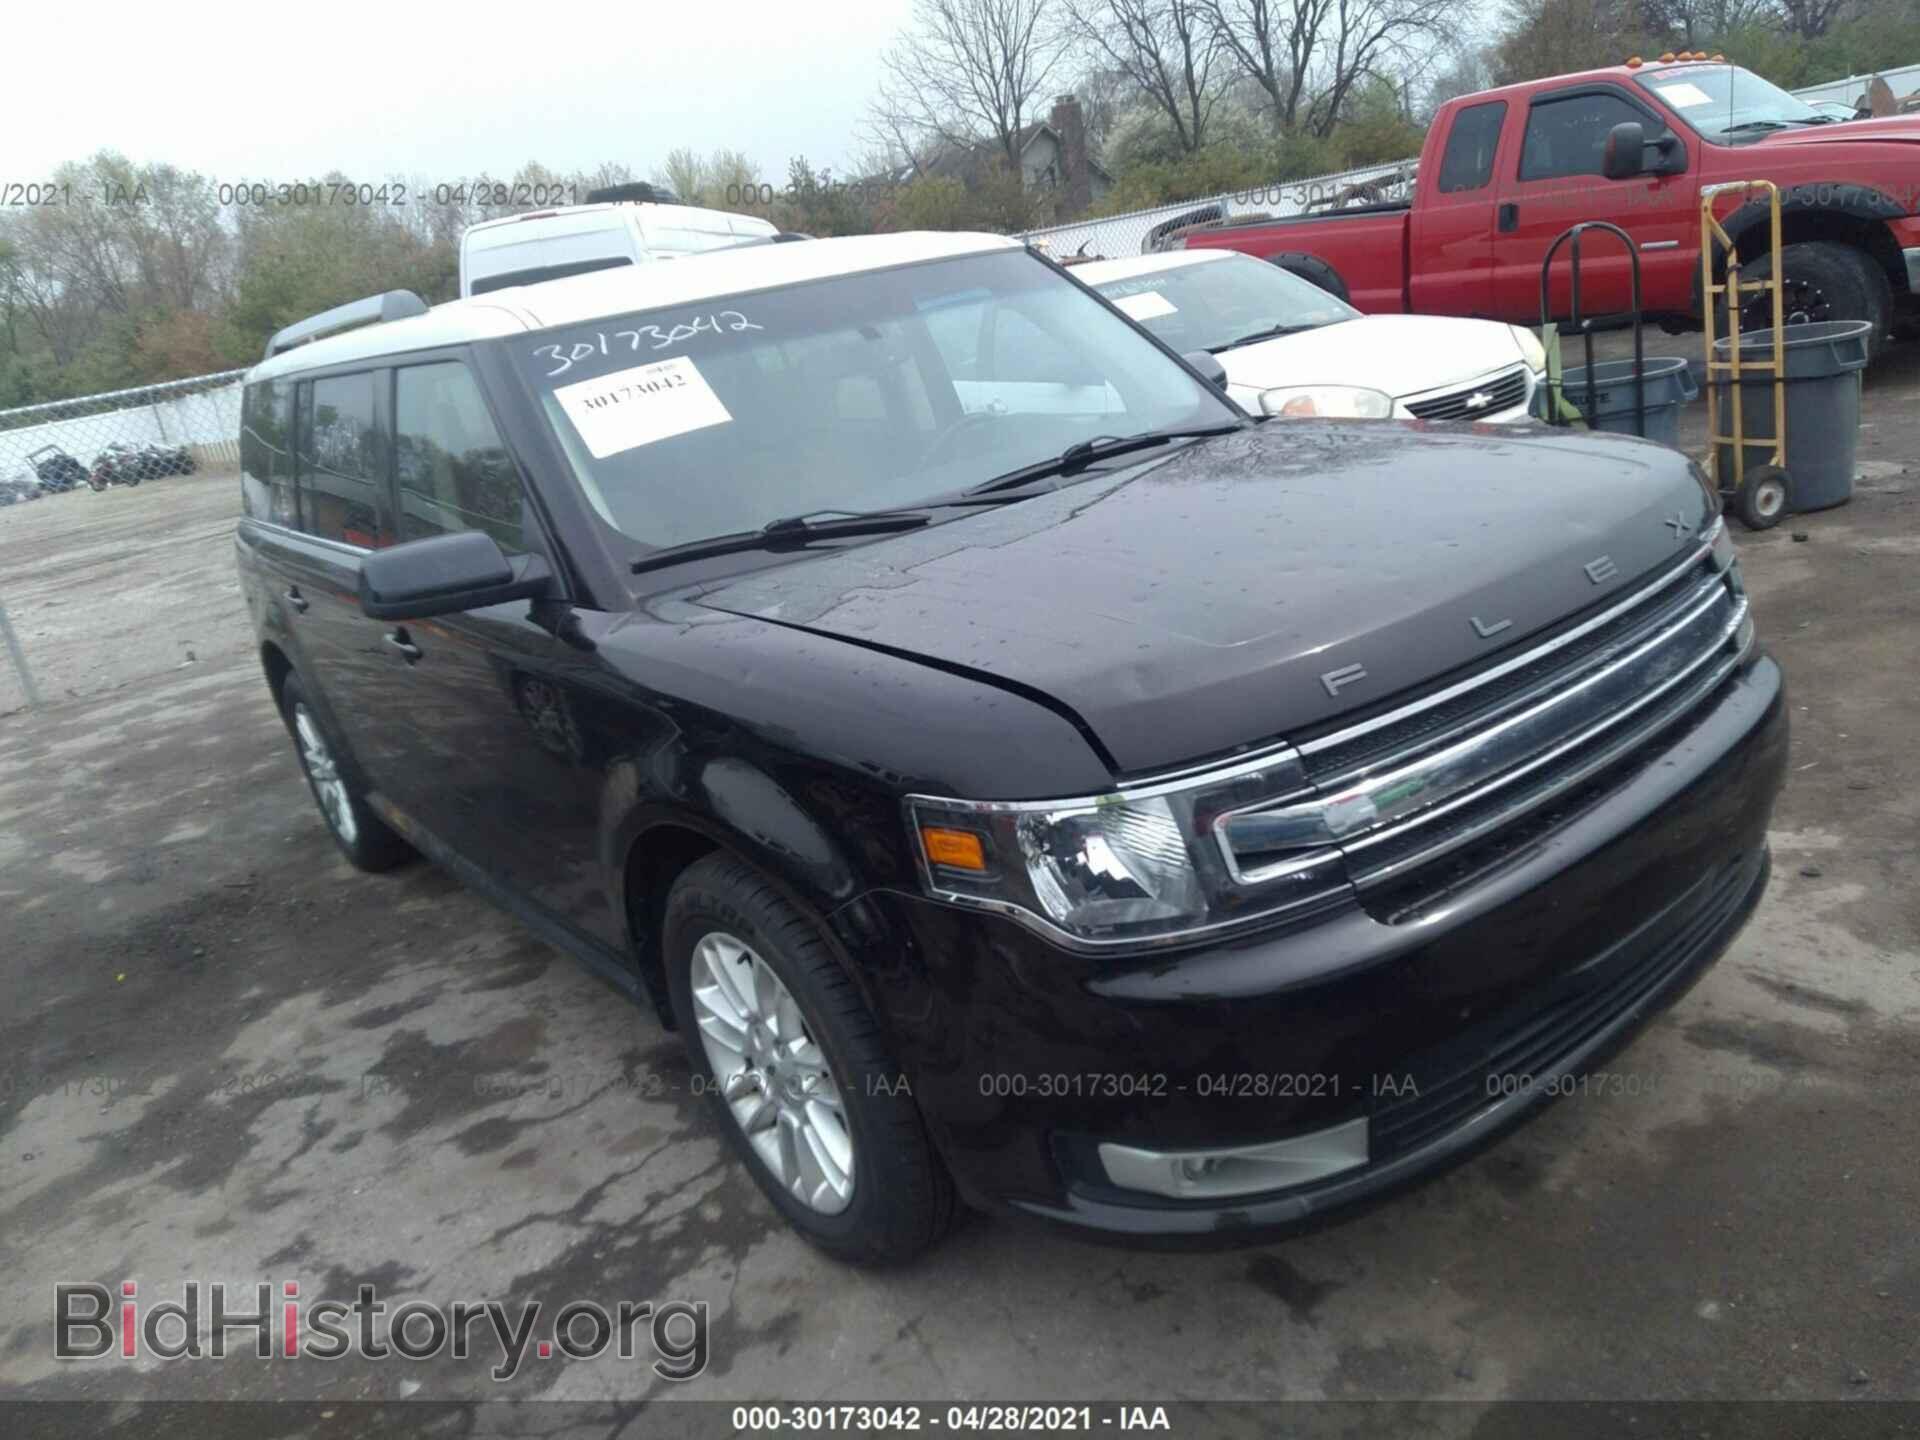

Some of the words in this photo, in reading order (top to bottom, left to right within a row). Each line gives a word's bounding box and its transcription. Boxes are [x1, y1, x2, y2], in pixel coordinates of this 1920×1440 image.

[533, 311, 763, 376] 30173042
[583, 374, 687, 411] 30173042
[1320, 511, 1692, 696] FLEX
